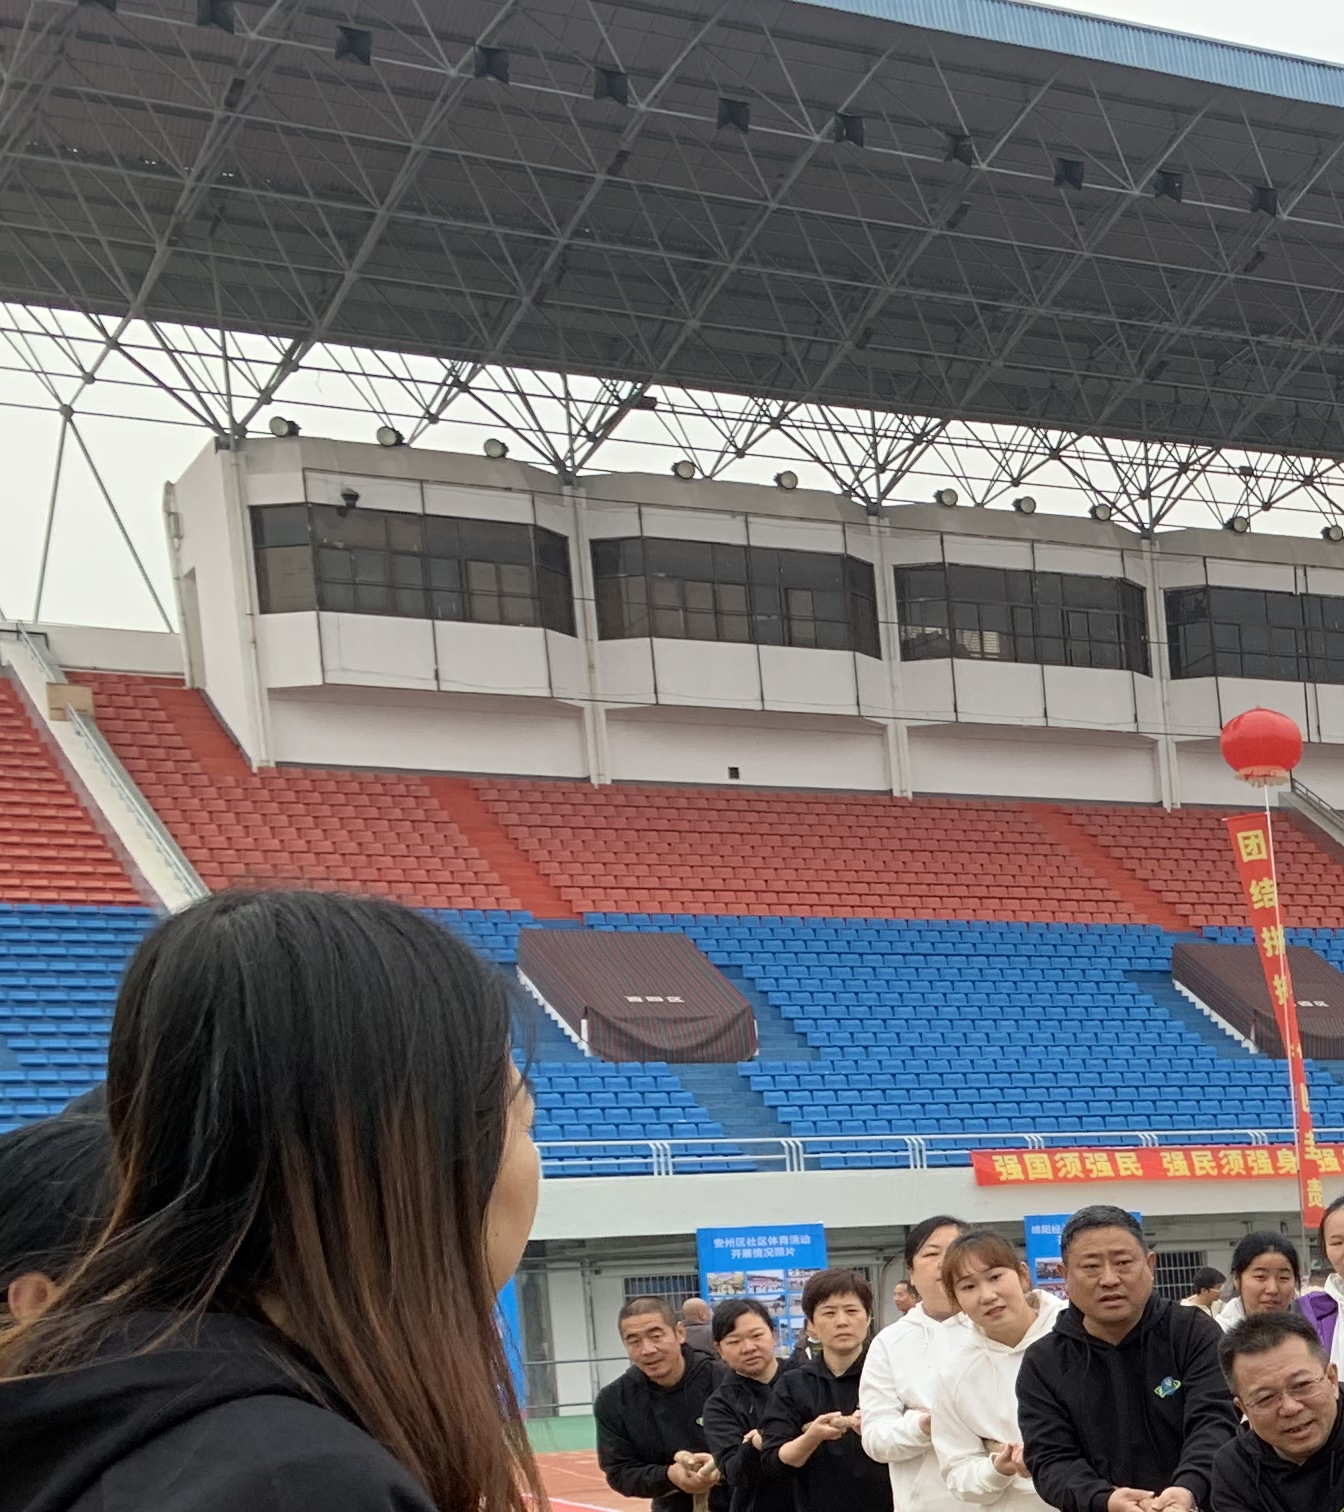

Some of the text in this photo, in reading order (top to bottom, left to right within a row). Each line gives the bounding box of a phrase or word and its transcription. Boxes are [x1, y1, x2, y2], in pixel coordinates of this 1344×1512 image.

[993, 1149, 1144, 1180] 强国须强民
[1160, 1146, 1298, 1179] 强民须强身
